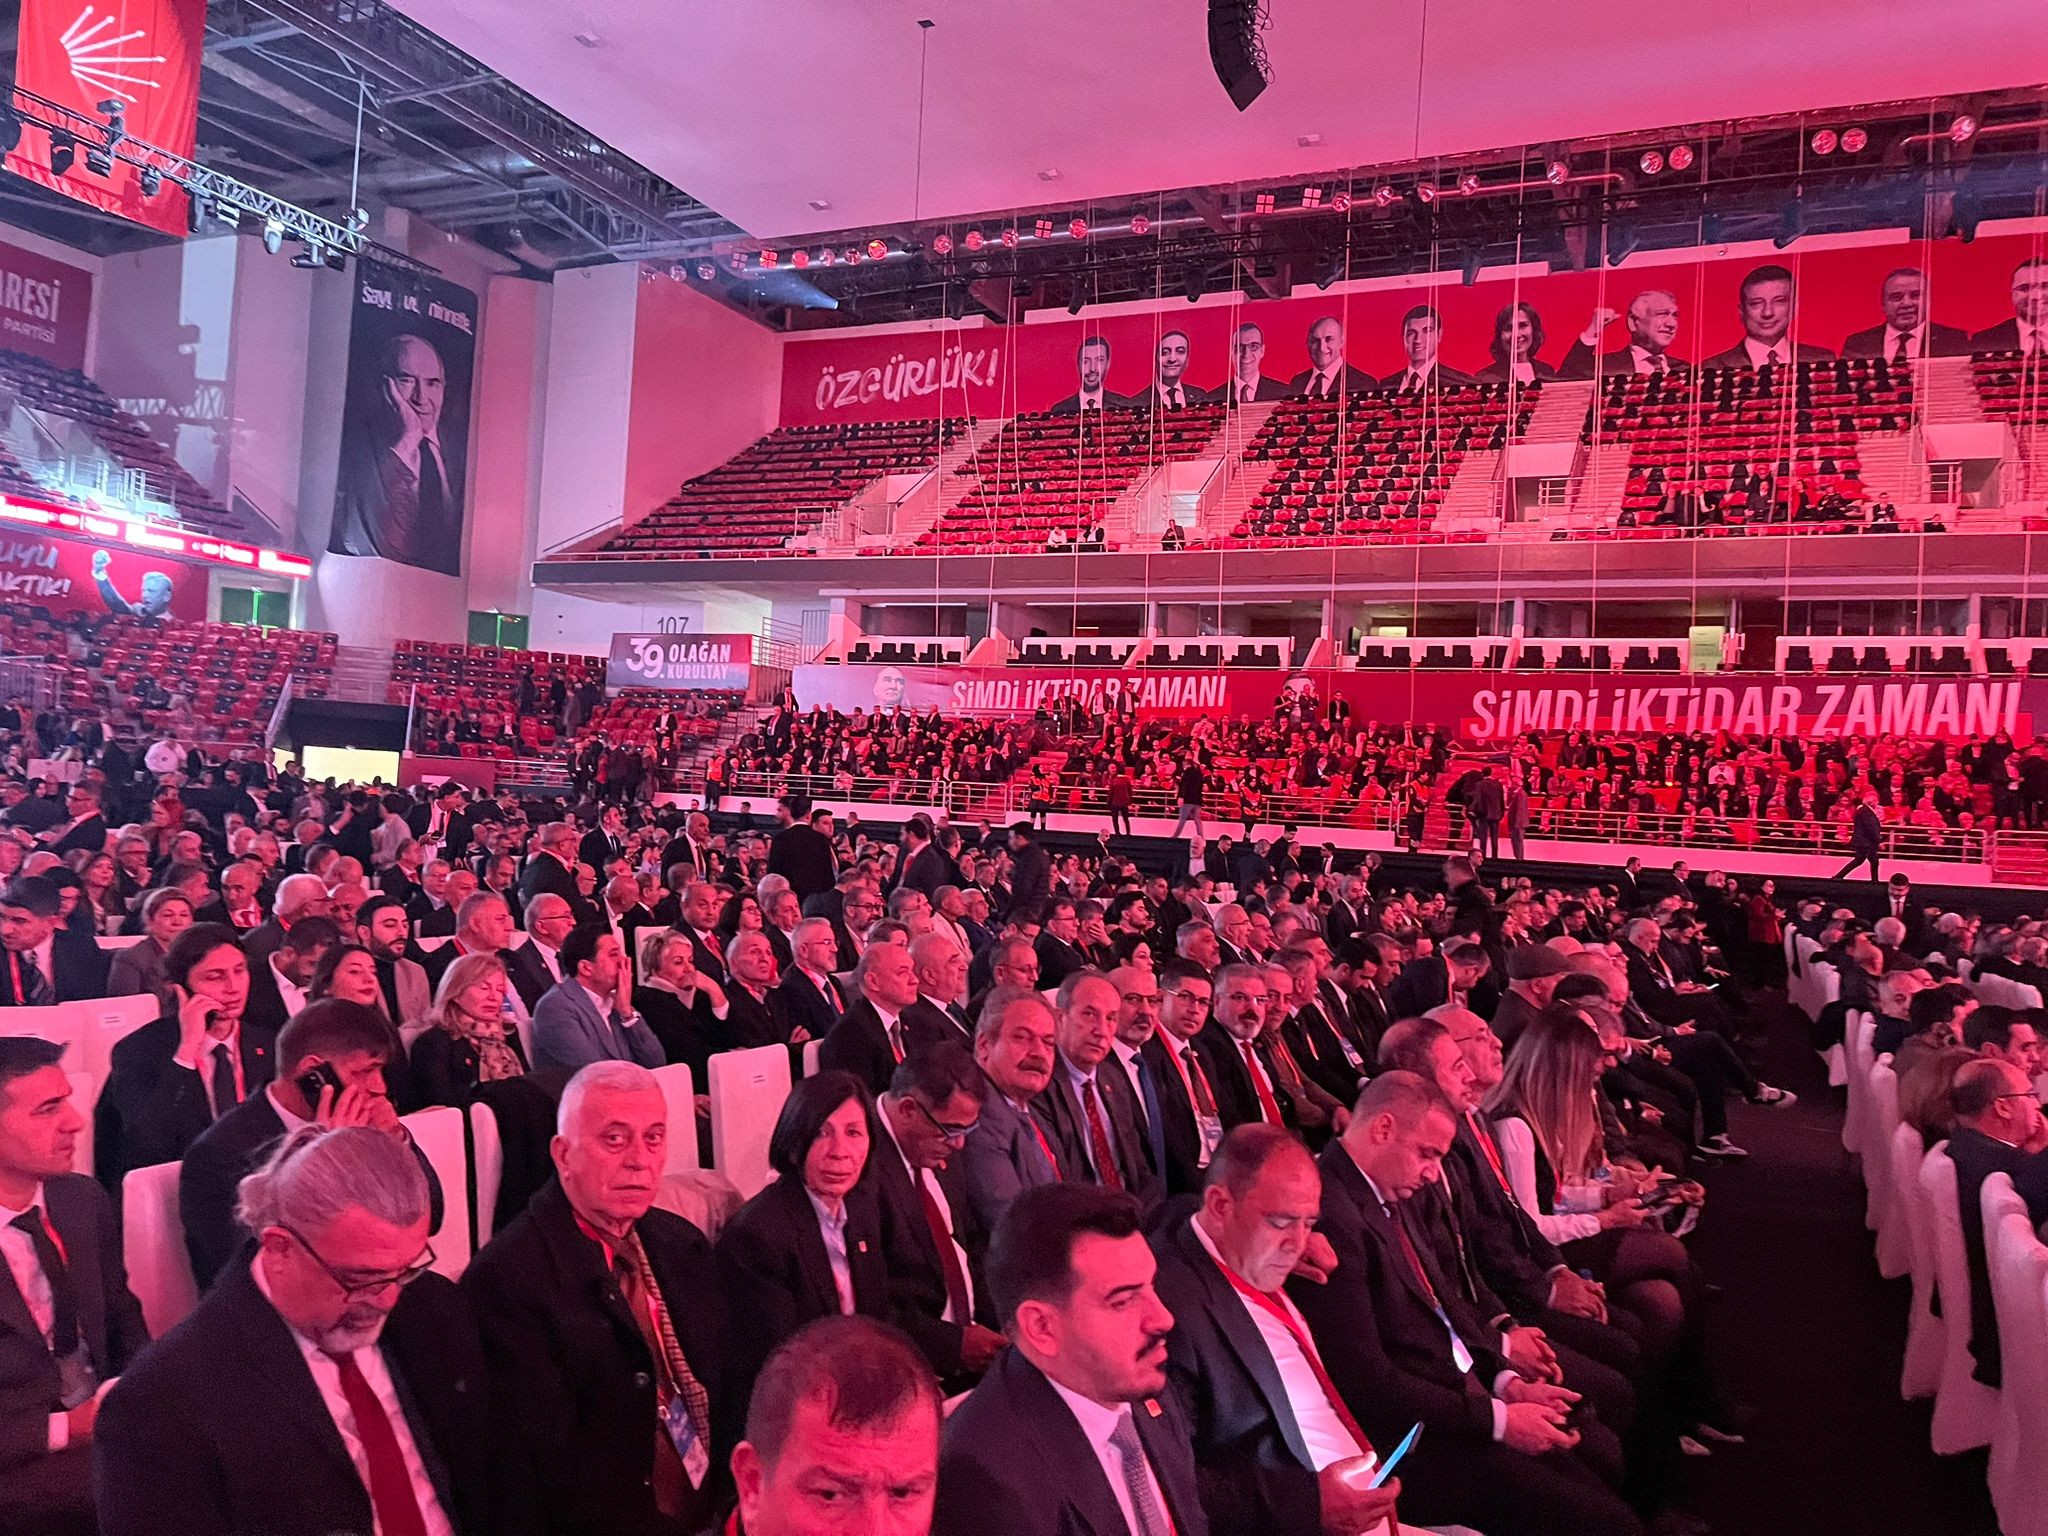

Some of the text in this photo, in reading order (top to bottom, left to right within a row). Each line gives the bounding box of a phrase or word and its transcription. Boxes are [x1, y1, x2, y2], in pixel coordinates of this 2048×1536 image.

[0, 268, 62, 323] RESİ
[815, 345, 999, 411] ÖZGÜRLÜK!
[657, 616, 690, 635] 107
[668, 641, 732, 663] OLAĞAN
[667, 664, 729, 680] KURULTAY
[1811, 681, 2022, 737] ZAMANI
